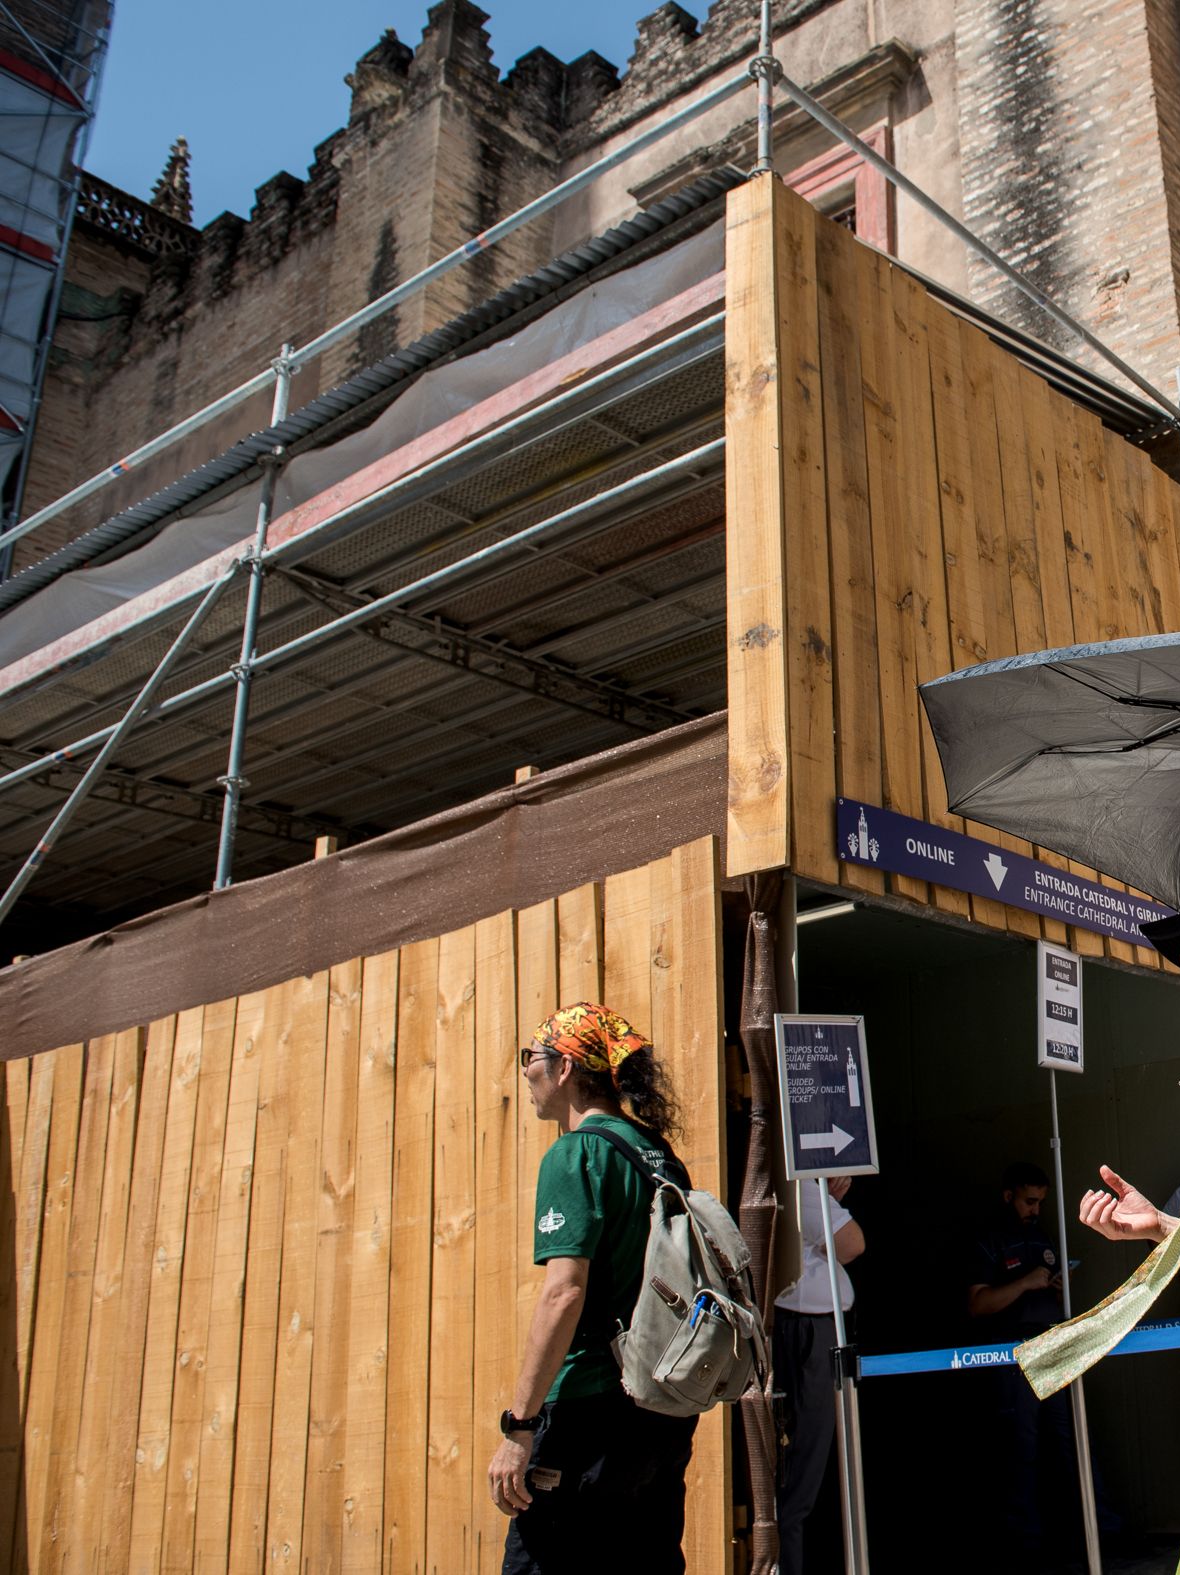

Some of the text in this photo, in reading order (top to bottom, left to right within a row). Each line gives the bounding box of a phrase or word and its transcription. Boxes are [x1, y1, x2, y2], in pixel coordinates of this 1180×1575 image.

[906, 838, 955, 865] ONLINE
[1034, 871, 1167, 922] ENTRADA CATEDRAL Y GIRA
[1024, 886, 1147, 938] ENTRANCE CATHEDRAL AN
[1051, 957, 1072, 970] ENTRADA
[1054, 971, 1070, 982] ONLINE
[1051, 1003, 1073, 1018] 12:15 H
[785, 1046, 812, 1054] GRUPOS
[807, 1054, 838, 1062] ENTRADA
[786, 1063, 812, 1071] ONLINE
[787, 1078, 814, 1086] GUIDED
[788, 1086, 846, 1095] GROUPS/ ONLINE
[789, 1095, 813, 1104] TICKET
[962, 1351, 1011, 1365] CATEDRAL
